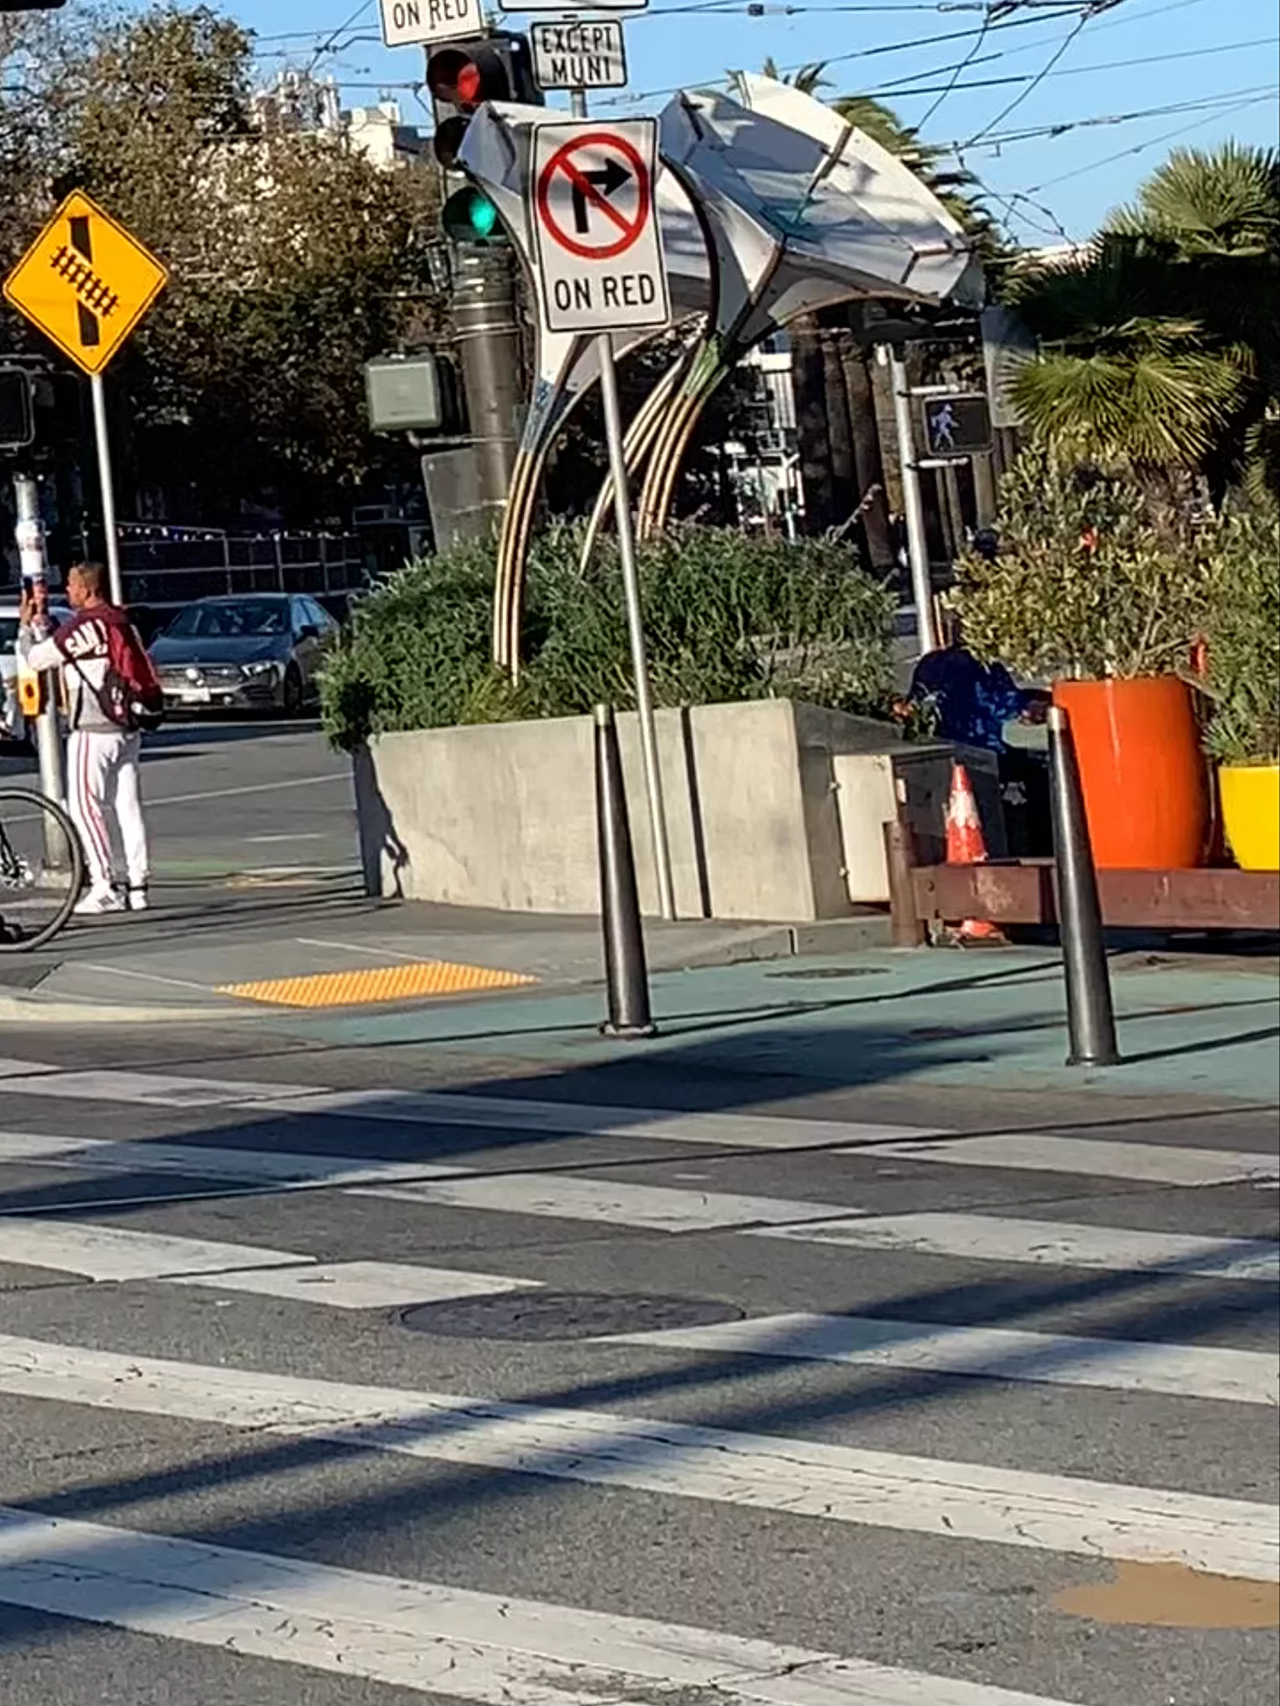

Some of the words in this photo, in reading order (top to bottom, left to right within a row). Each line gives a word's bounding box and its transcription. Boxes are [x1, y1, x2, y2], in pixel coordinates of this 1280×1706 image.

[393, 2, 420, 29] ON
[542, 27, 612, 53] EXCEPT
[551, 56, 612, 84] MUNI
[554, 279, 591, 311] ON
[602, 273, 655, 307] RED
